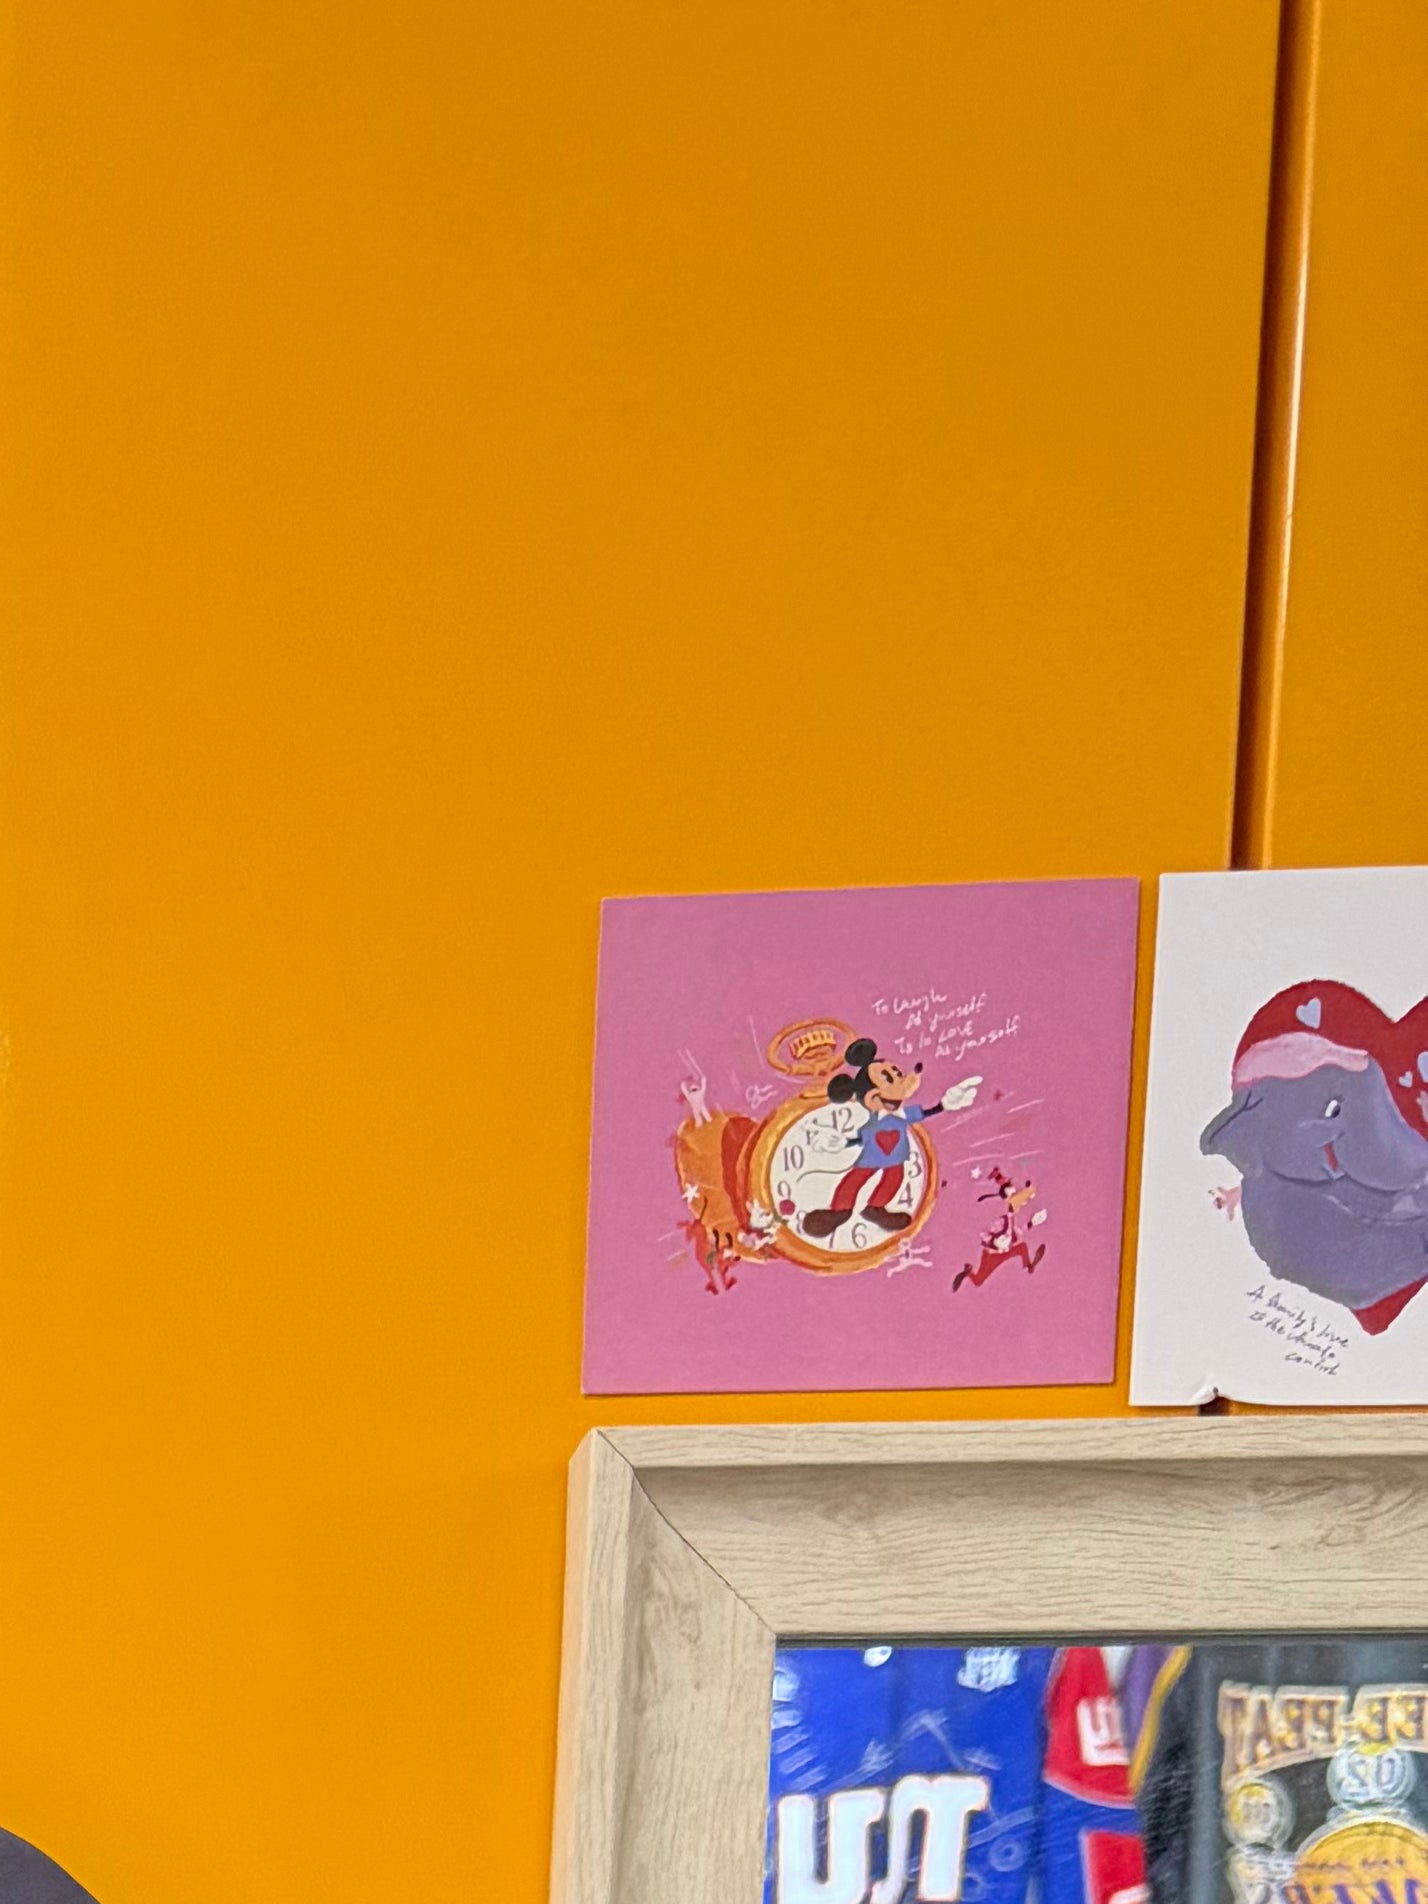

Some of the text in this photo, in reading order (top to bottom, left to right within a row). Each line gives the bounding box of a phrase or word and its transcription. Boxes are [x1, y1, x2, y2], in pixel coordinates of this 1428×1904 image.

[831, 1107, 855, 1133] 12
[783, 1145, 805, 1173] 10
[897, 1182, 914, 1208] 4
[851, 1222, 868, 1249] 6
